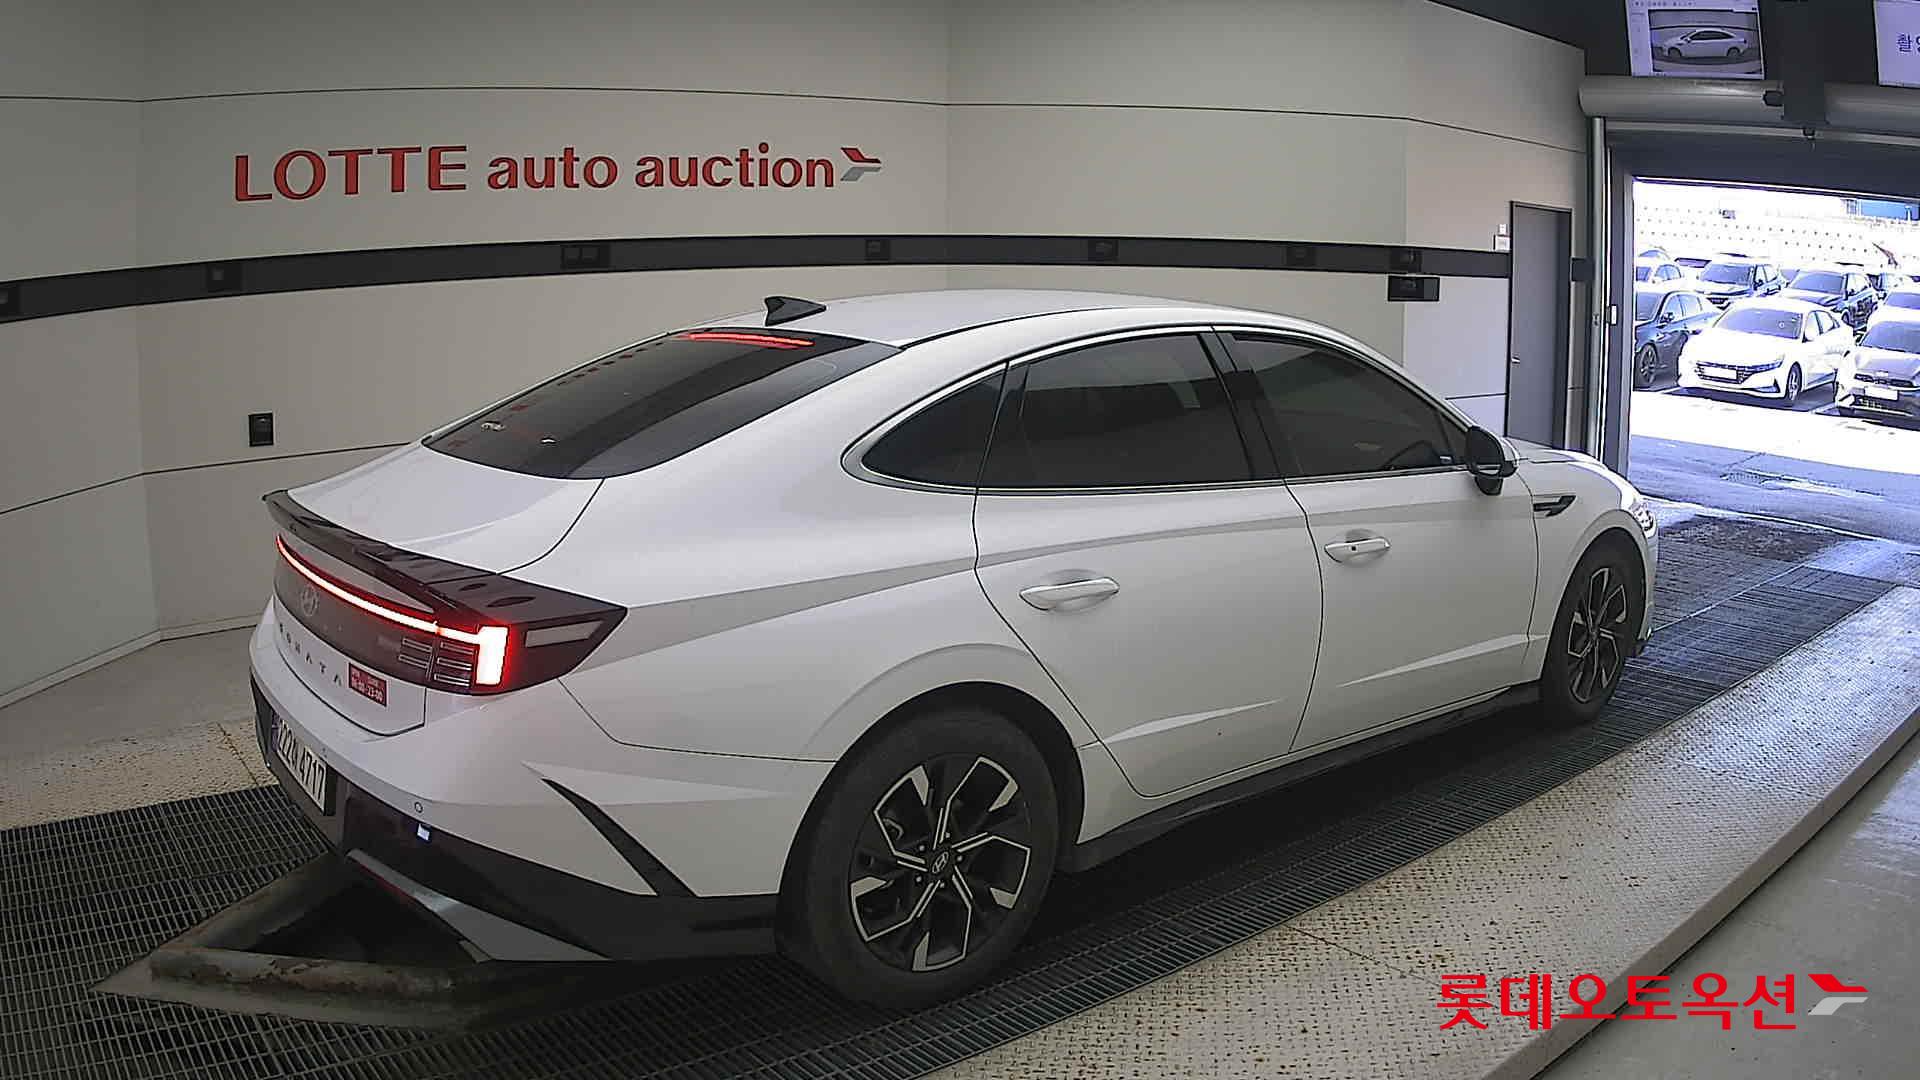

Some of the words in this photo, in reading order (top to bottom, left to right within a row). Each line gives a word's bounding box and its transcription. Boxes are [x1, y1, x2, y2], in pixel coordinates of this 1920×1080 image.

[235, 146, 467, 202] LOTTE
[488, 148, 618, 189] auto
[636, 142, 834, 188] auction
